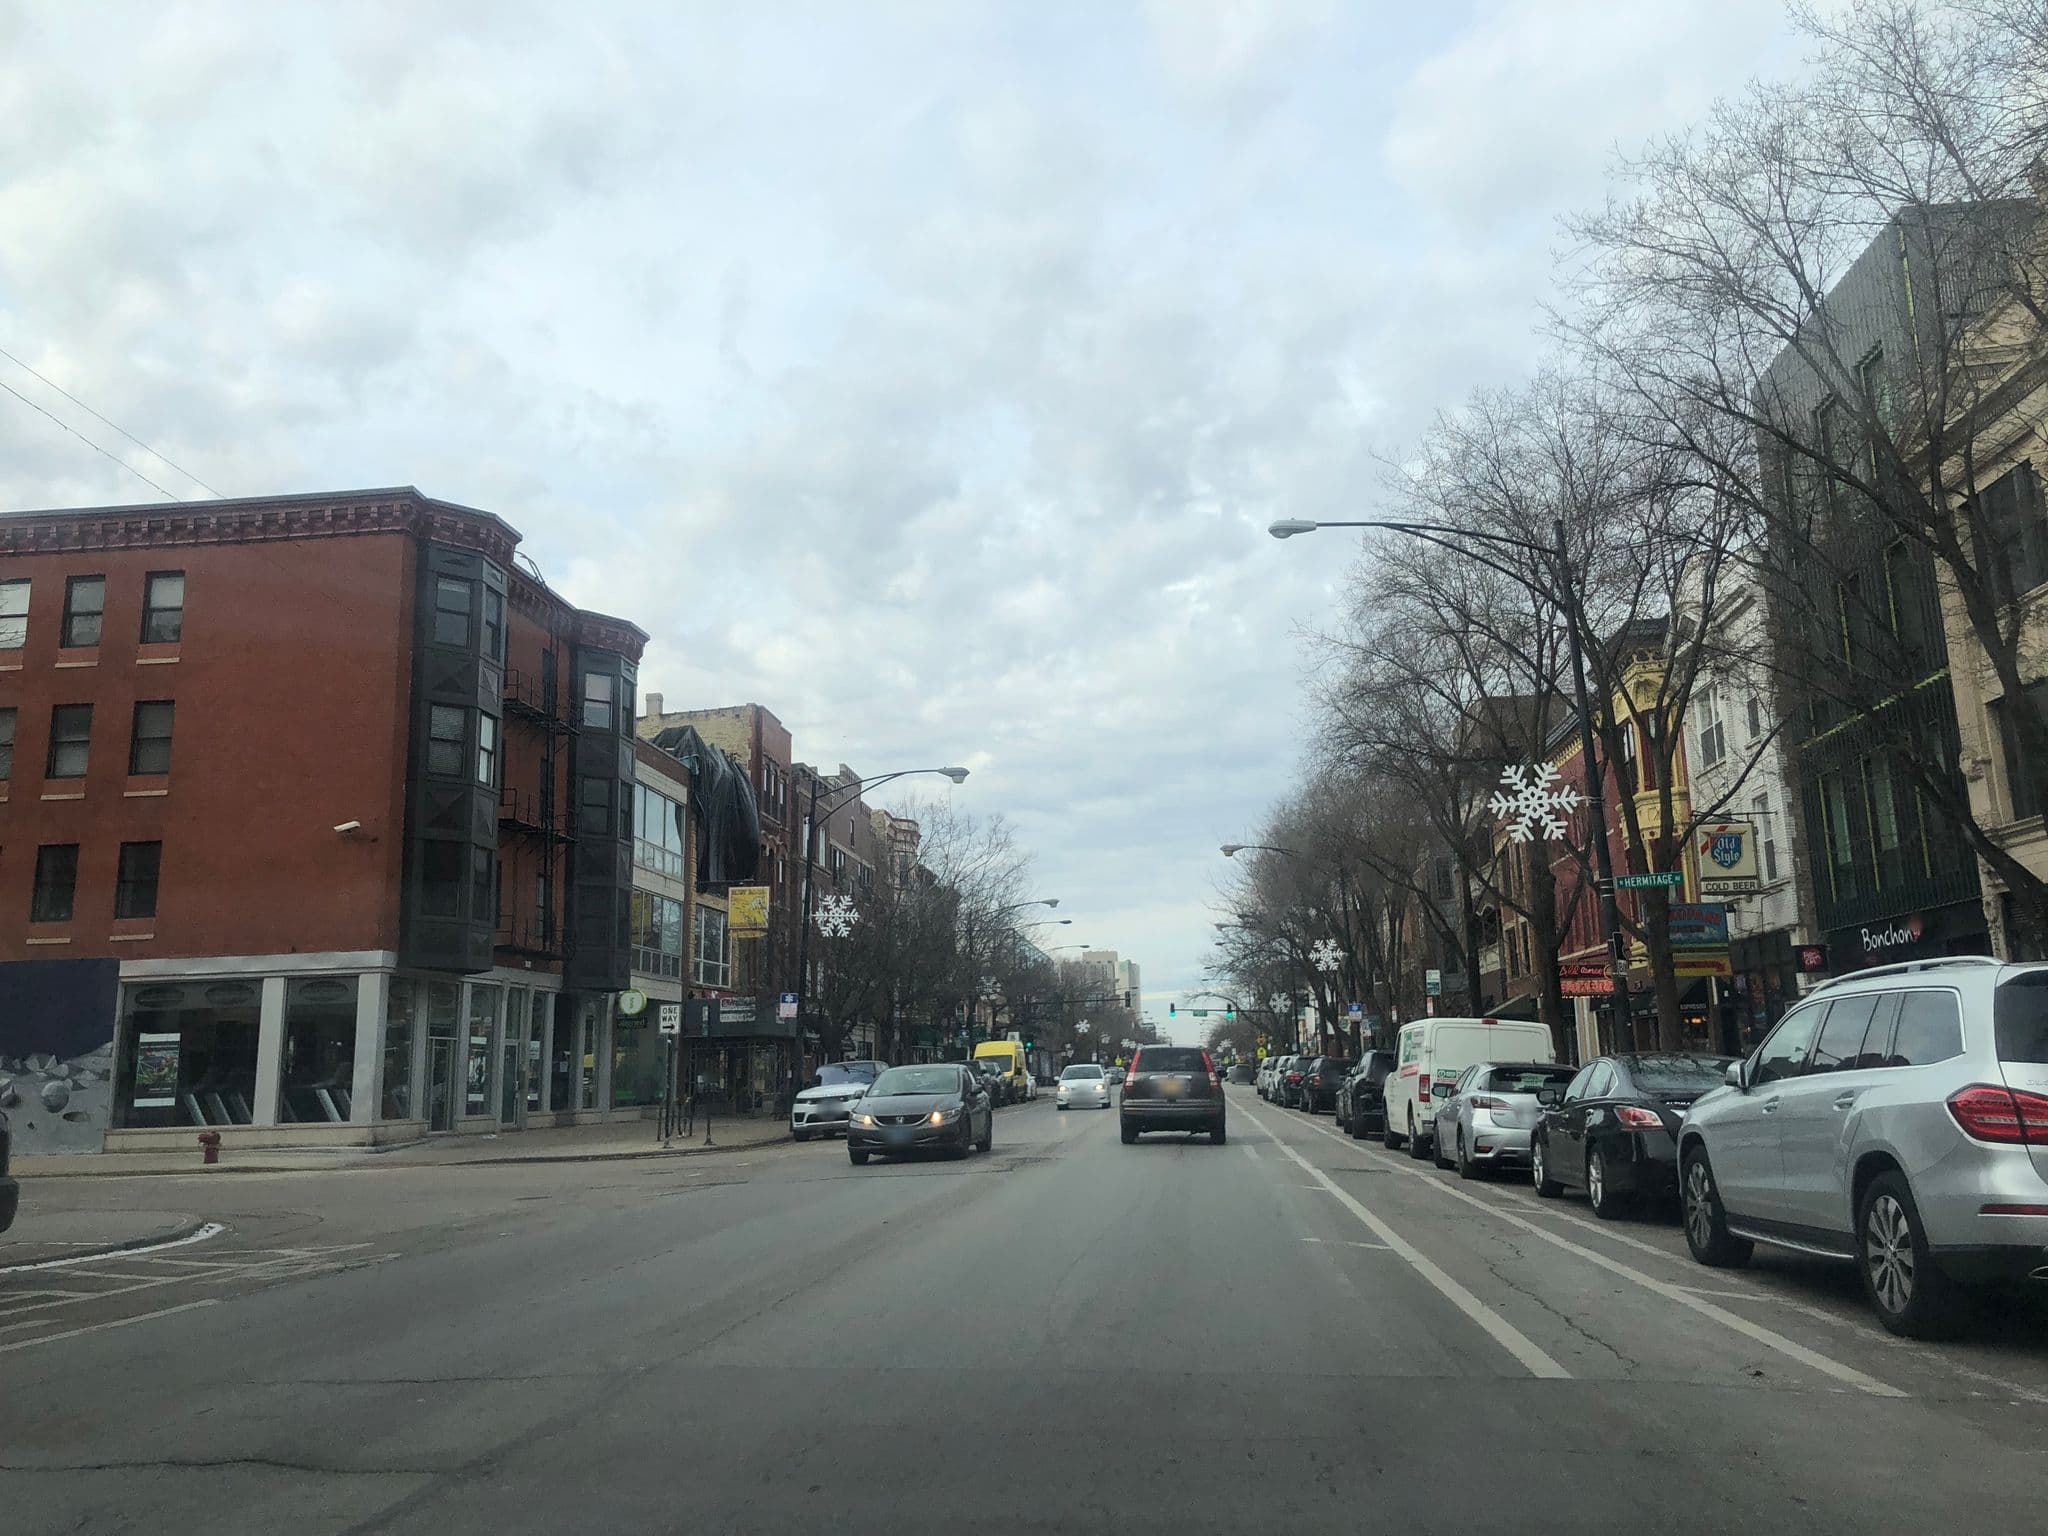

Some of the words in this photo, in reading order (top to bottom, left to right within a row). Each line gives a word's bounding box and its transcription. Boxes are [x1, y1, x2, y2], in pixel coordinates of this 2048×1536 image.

[1717, 837, 1735, 850] Old
[1713, 848, 1739, 867] Style
[1624, 873, 1674, 888] HERMITAGE
[1705, 882, 1729, 891] COLD
[1733, 881, 1755, 890] BEER
[1861, 922, 1912, 952] Bonchon
[662, 1006, 678, 1015] ONE
